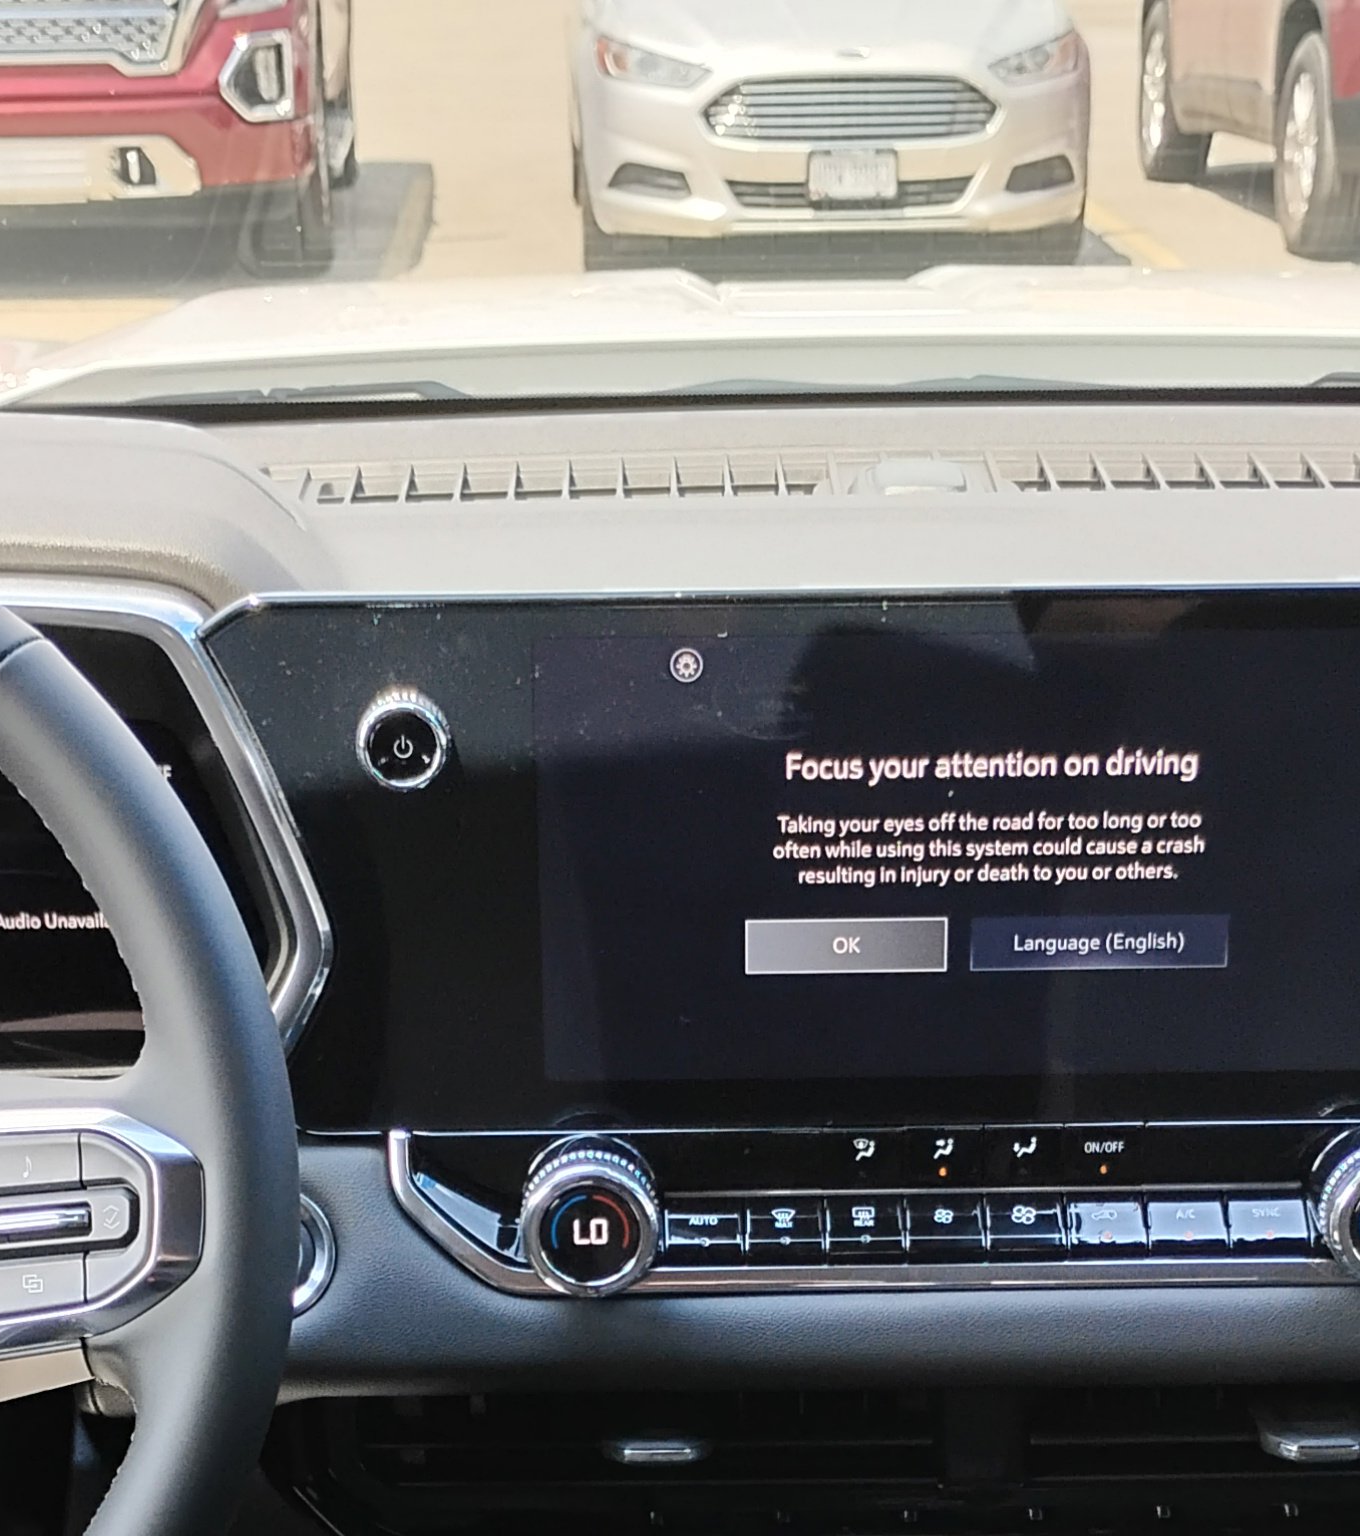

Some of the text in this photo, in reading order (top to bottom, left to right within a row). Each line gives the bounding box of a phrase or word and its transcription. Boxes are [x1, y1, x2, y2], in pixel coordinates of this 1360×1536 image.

[785, 747, 1200, 787] Focus your attention on driving
[777, 810, 1202, 838] Taking your eyes off the road for too long or too
[772, 835, 1205, 862] often while using this system could cause a crash
[798, 861, 1179, 888] resulting in injury or death to you or others.
[832, 936, 861, 954] OK
[1013, 931, 1185, 956] Language (English)
[1083, 1141, 1125, 1154] ON/OFF
[689, 1215, 719, 1226] AUTO
[1175, 1208, 1196, 1219] A/C
[1252, 1207, 1281, 1218] SYNC
[572, 1217, 609, 1246] LO
